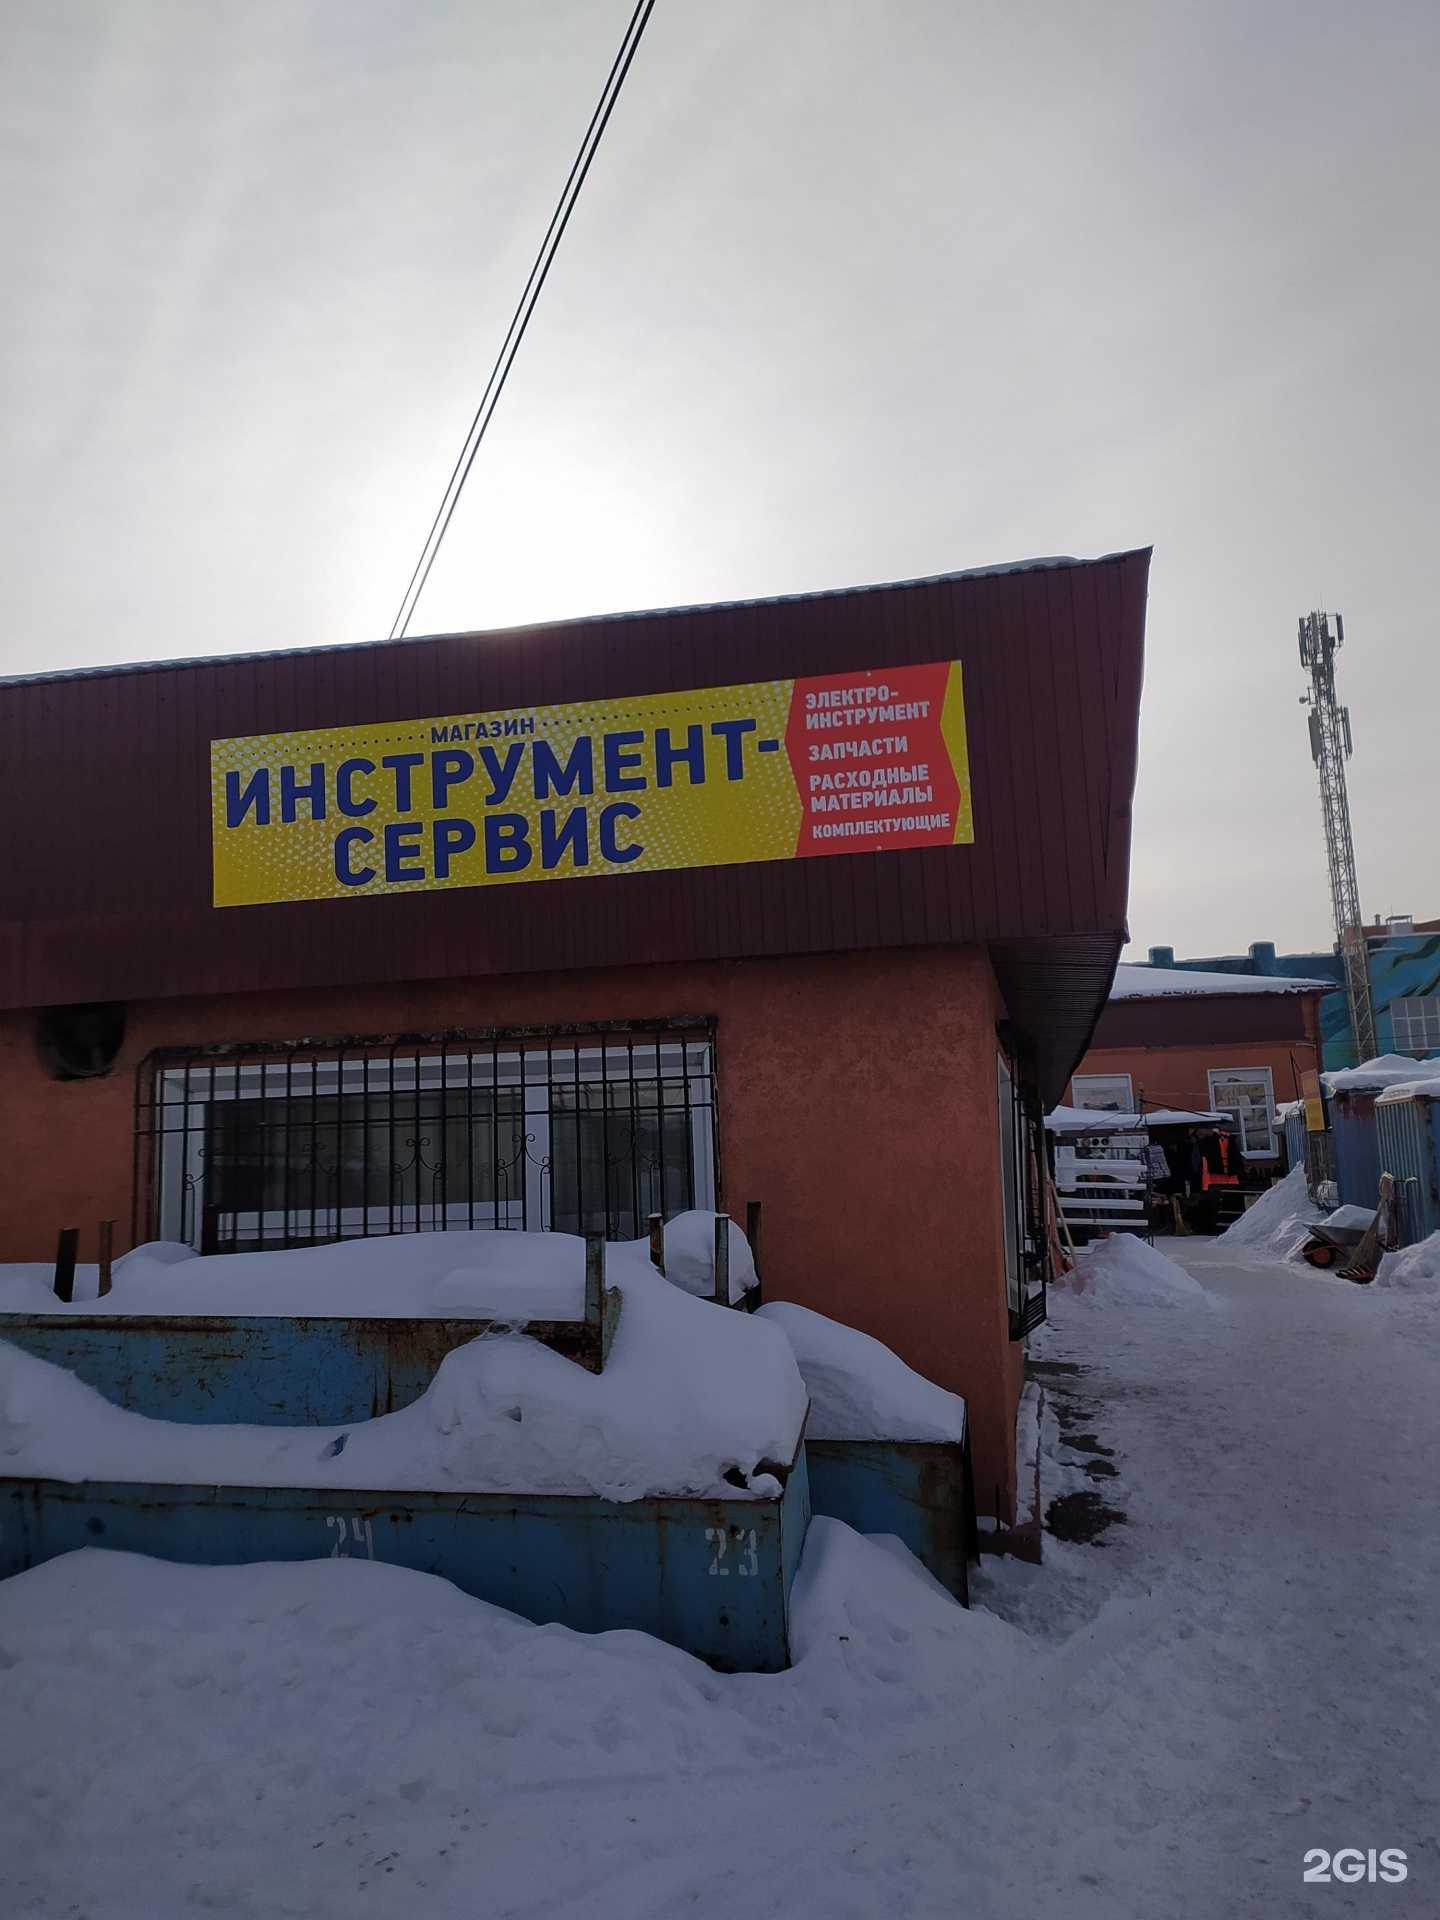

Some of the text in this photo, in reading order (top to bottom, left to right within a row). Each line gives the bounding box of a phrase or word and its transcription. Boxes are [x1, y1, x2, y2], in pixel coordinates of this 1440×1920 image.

[805, 685, 899, 710] ЭЛЕКТРО-
[806, 701, 930, 730] ИНСТРУМЕНТ
[431, 717, 535, 743] МАГАЗИН
[808, 736, 908, 761] ЗАПЧАСТИ
[225, 719, 780, 829] ИНСТРУМЕНТ-
[809, 764, 929, 791] РАСХОДНЫЕ
[811, 785, 933, 813] МАТЕРИАЛЫ
[812, 813, 951, 839] КОМПЛЕКТУЮЩИЕ
[334, 802, 645, 886] СЕРВИС
[326, 1516, 374, 1560] 24
[705, 1527, 759, 1576] 23
